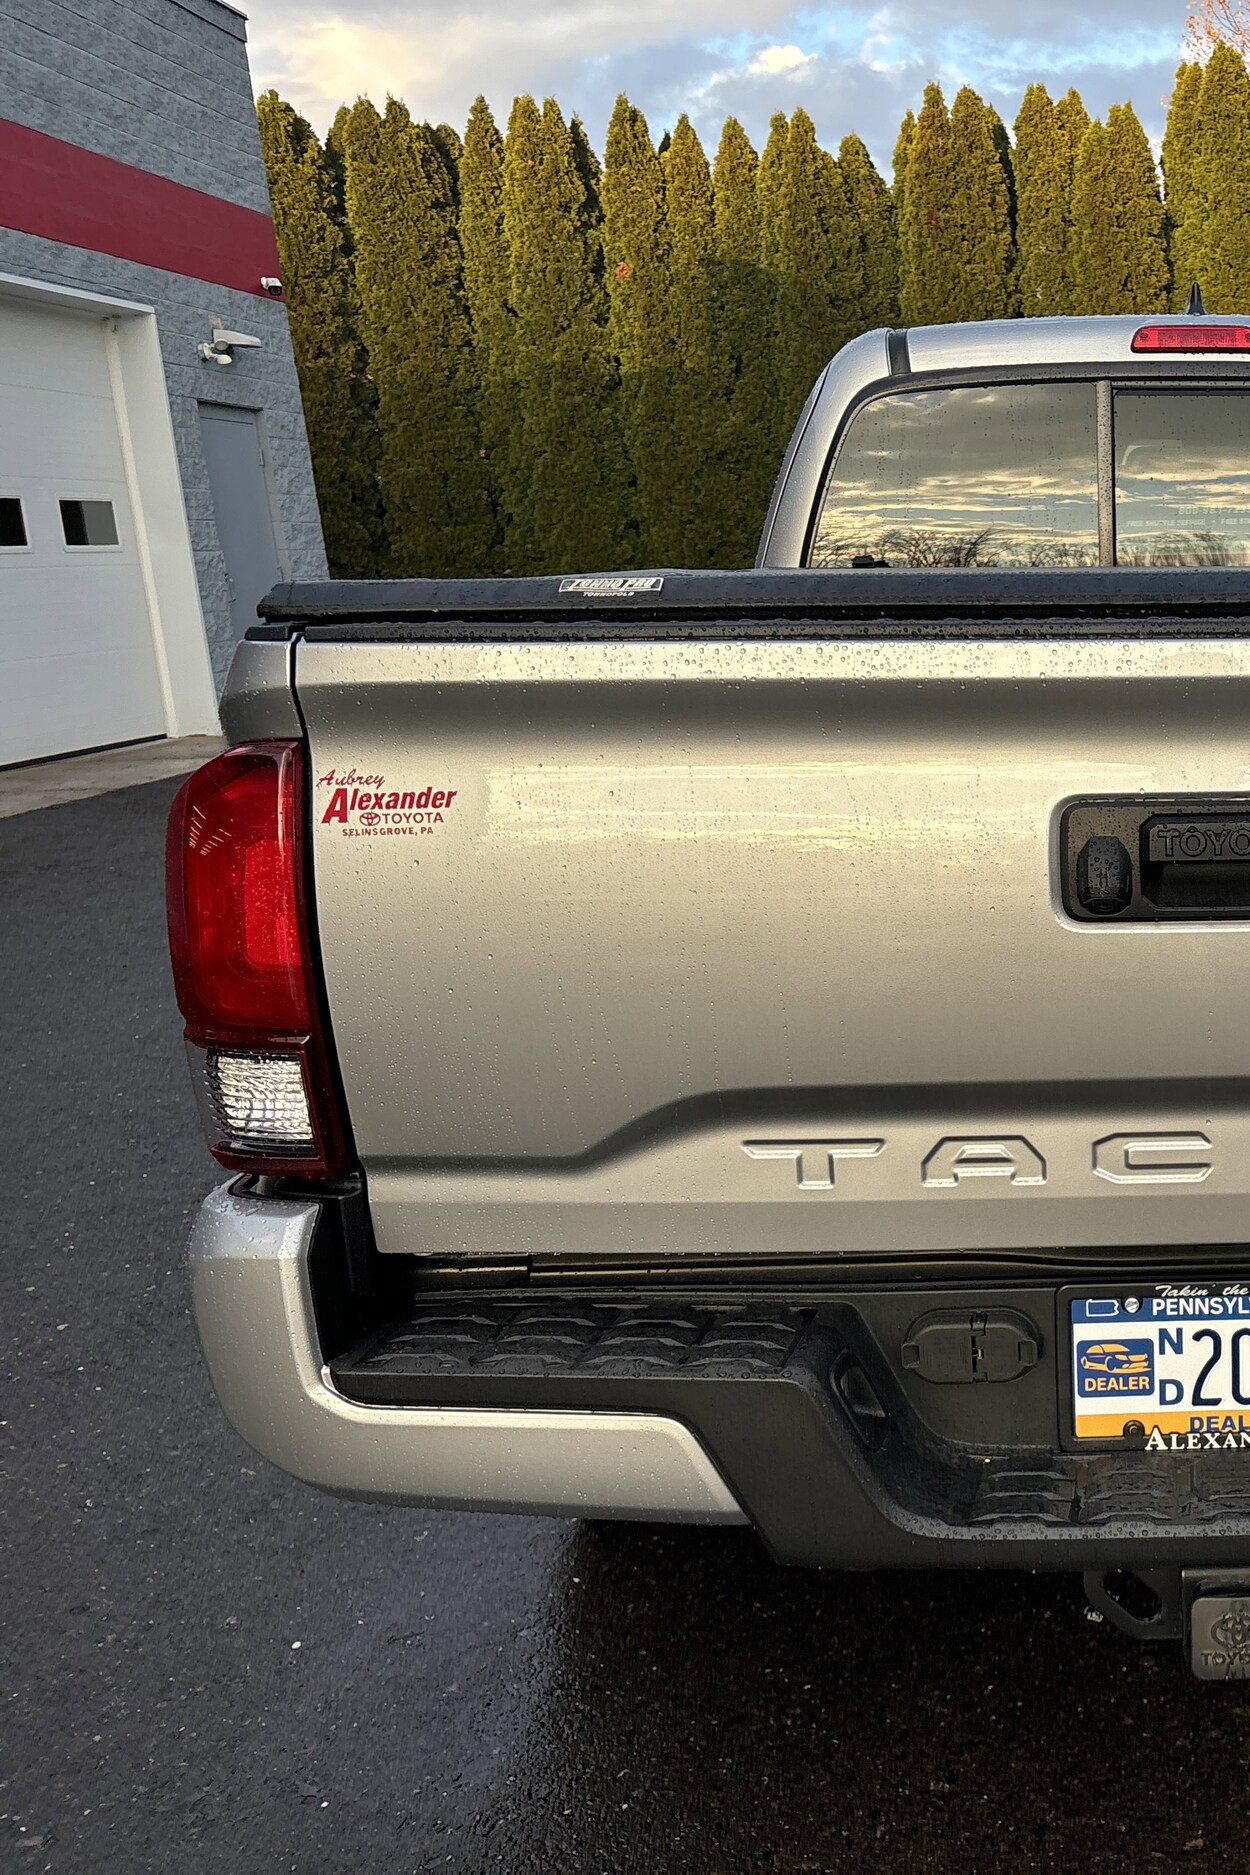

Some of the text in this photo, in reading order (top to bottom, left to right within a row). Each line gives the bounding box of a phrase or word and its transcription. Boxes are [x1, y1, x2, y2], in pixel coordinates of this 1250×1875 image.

[316, 769, 385, 789] Aubrey
[321, 786, 457, 824] Alexander
[382, 812, 444, 824] TOYOTA
[342, 827, 433, 836] SELINSGROVE, PA
[1155, 1283, 1216, 1297] Takin'
[1222, 1283, 1249, 1295] the
[1084, 1376, 1150, 1392] DEALER
